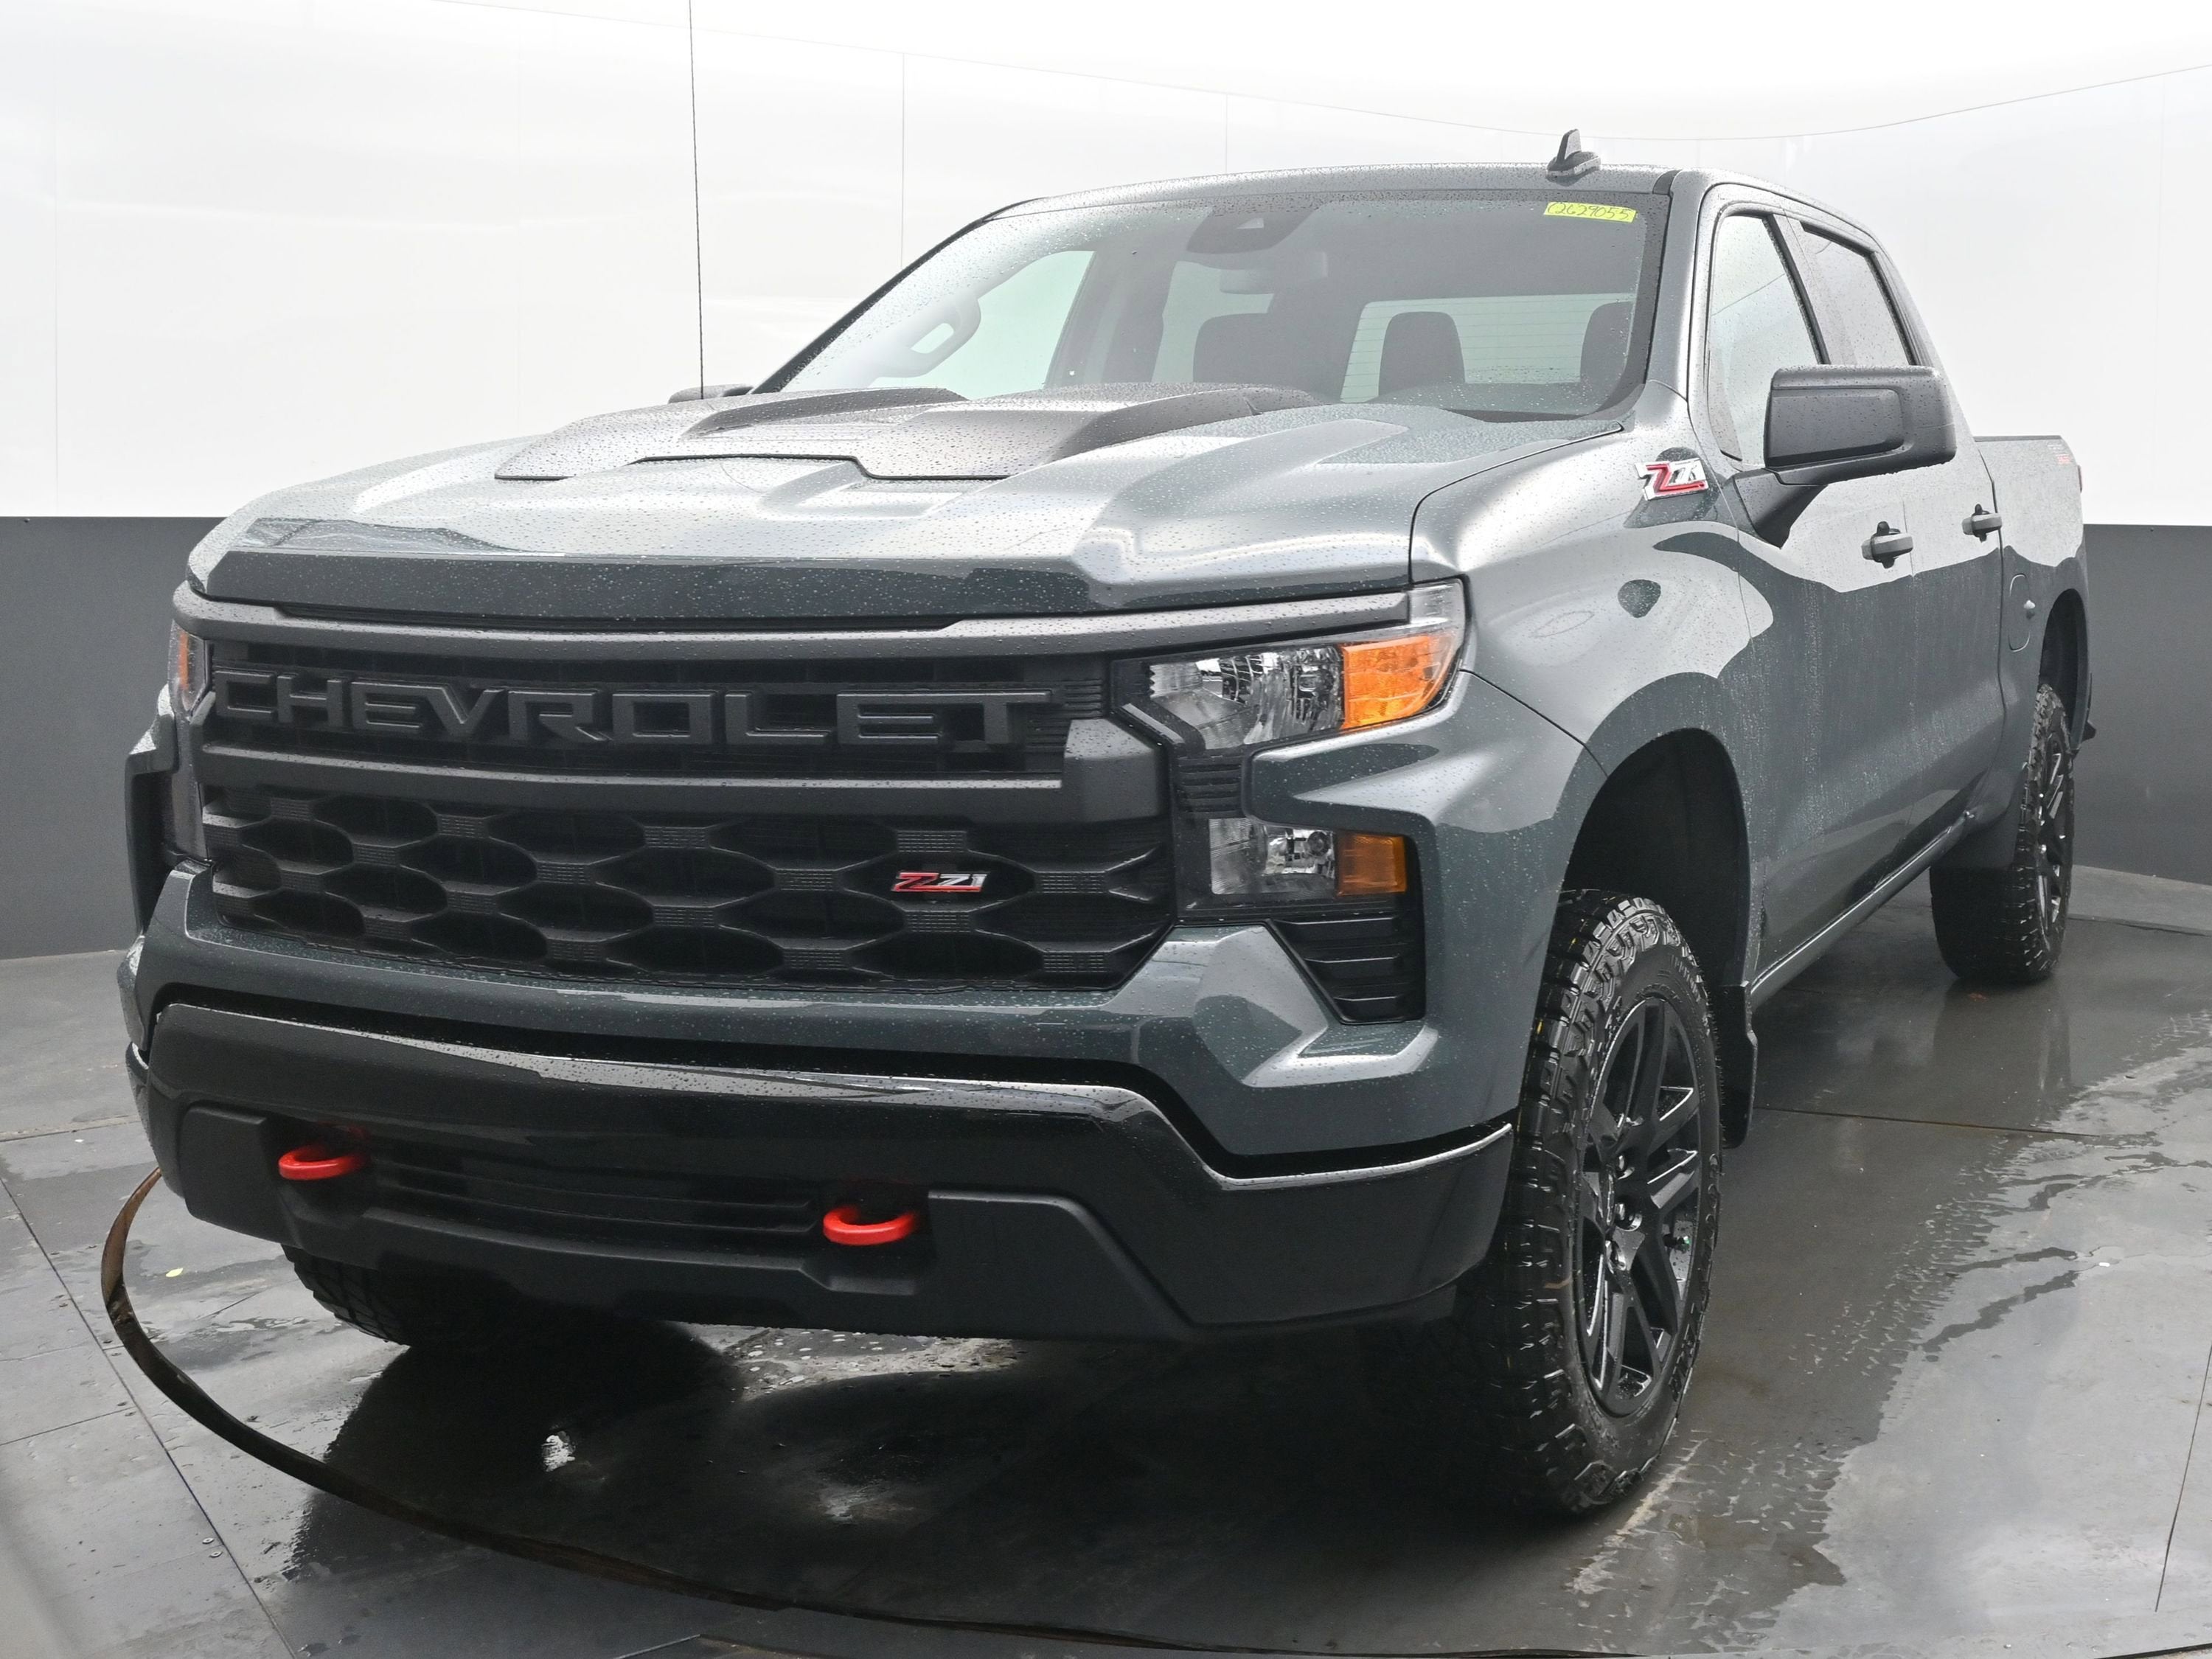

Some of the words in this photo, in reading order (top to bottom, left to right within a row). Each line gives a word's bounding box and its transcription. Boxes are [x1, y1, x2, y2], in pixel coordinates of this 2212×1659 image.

[1635, 457, 1709, 501] Z71
[213, 668, 1054, 745] CHEVROLET
[891, 872, 987, 892] Z71
